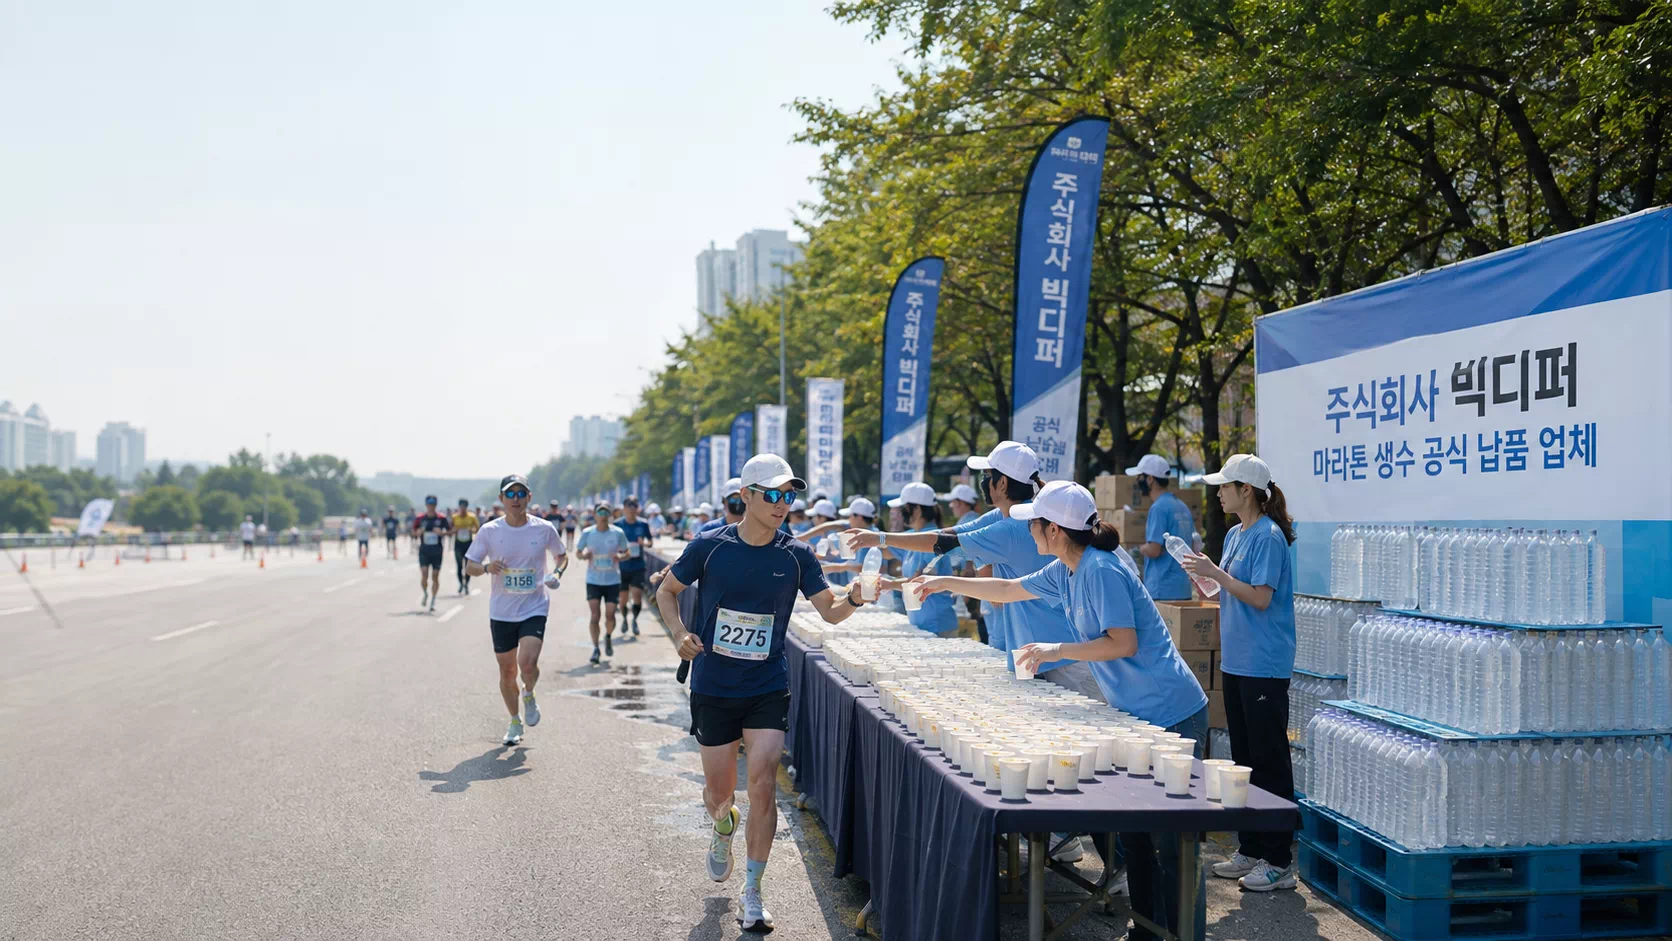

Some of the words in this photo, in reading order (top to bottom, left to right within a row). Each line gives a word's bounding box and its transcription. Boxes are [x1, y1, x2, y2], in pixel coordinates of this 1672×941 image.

[1044, 171, 1079, 273] 주식회사
[901, 291, 924, 357] 주식회사
[1034, 278, 1070, 368] 빅디퍼
[896, 359, 918, 417] 빅디퍼
[1325, 369, 1440, 434] 주식회사
[1451, 342, 1577, 417] 빅디퍼
[1032, 415, 1061, 434] 공식
[1313, 444, 1368, 482] 마라톤
[1374, 440, 1415, 480] 생수
[1422, 433, 1467, 477] 공식
[1477, 428, 1530, 473] 납품
[1538, 422, 1597, 470] 업체
[719, 624, 767, 648] 2275
